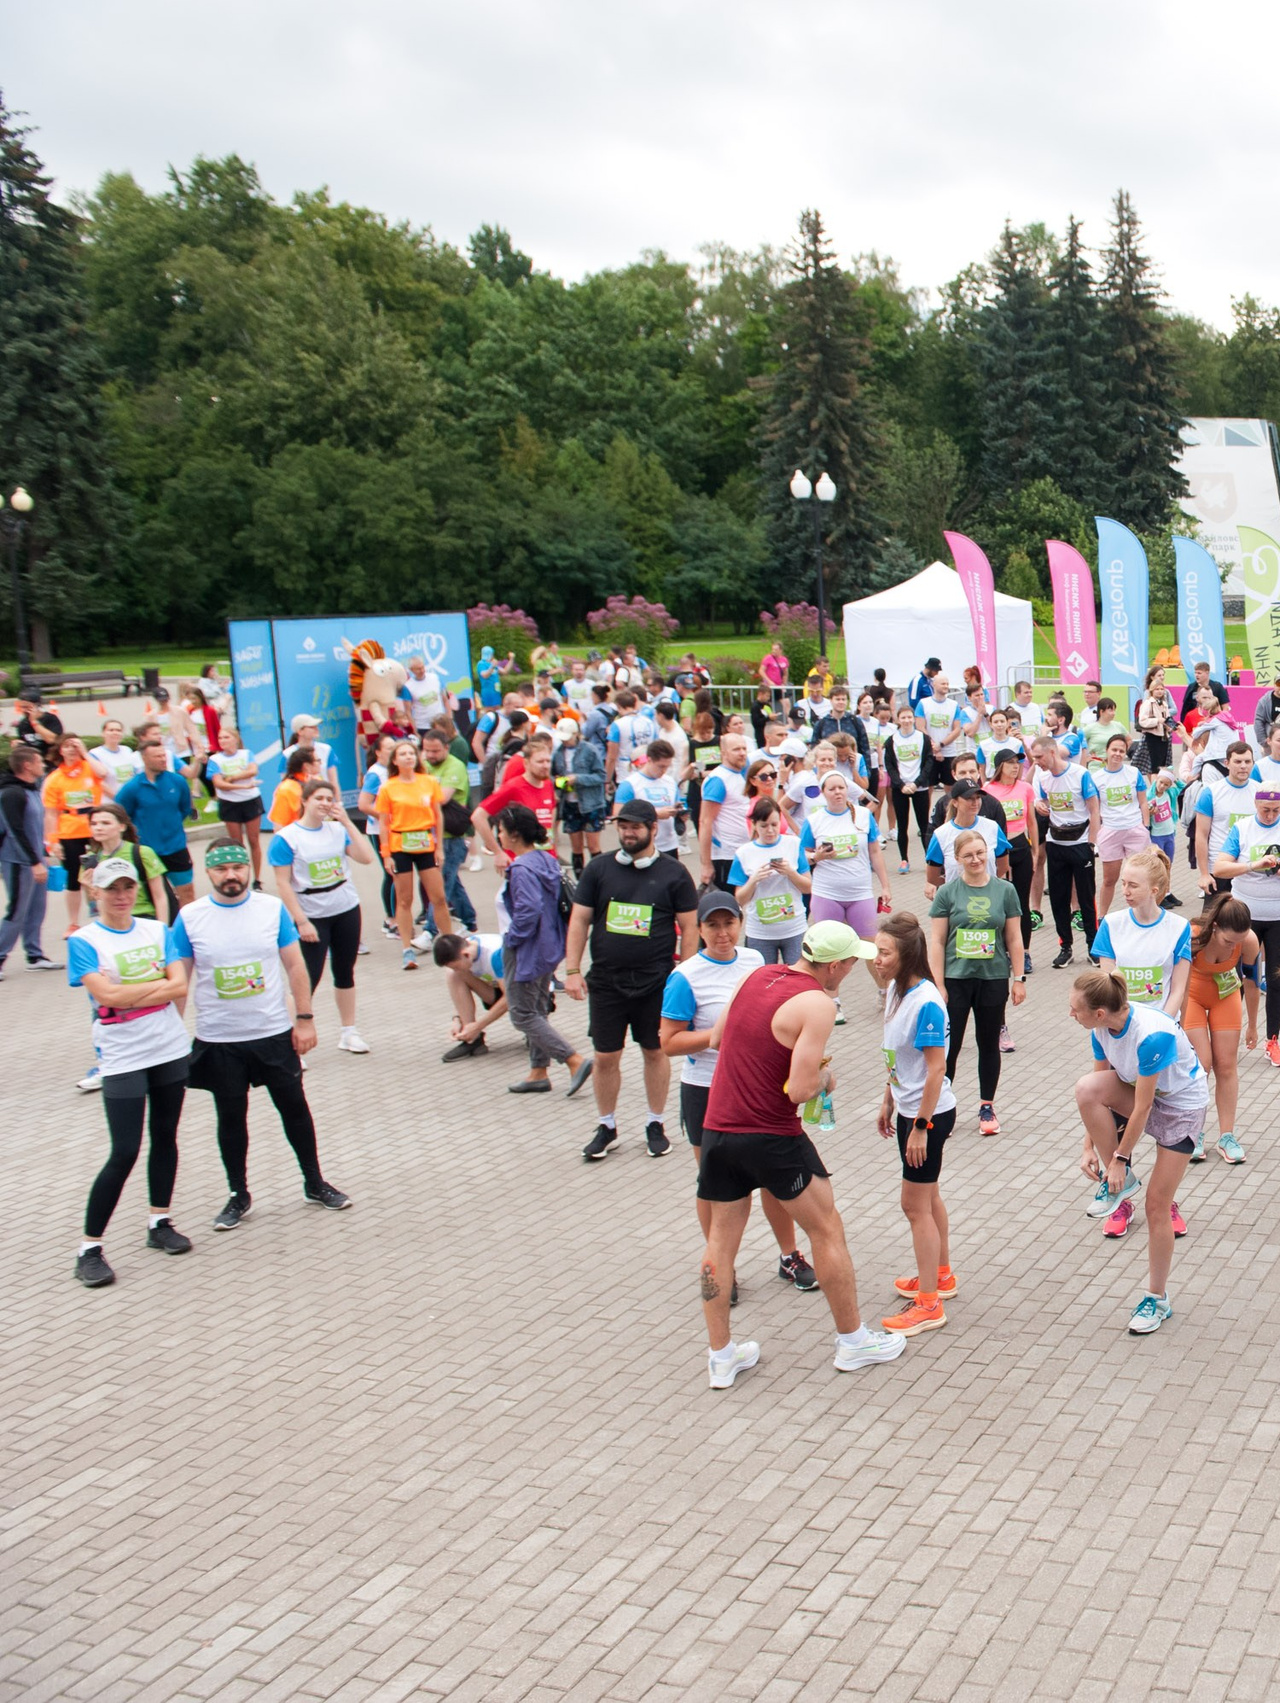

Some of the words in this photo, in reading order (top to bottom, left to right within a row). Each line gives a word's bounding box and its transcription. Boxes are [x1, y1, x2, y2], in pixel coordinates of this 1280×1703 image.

[1212, 543, 1235, 552] парк
[315, 859, 338, 871] 1414
[762, 896, 787, 908] 1543
[617, 905, 641, 917] 1171
[962, 931, 989, 941] 1309
[123, 947, 157, 964] 1549
[220, 965, 256, 980] 1548
[1124, 969, 1153, 980] 1198
